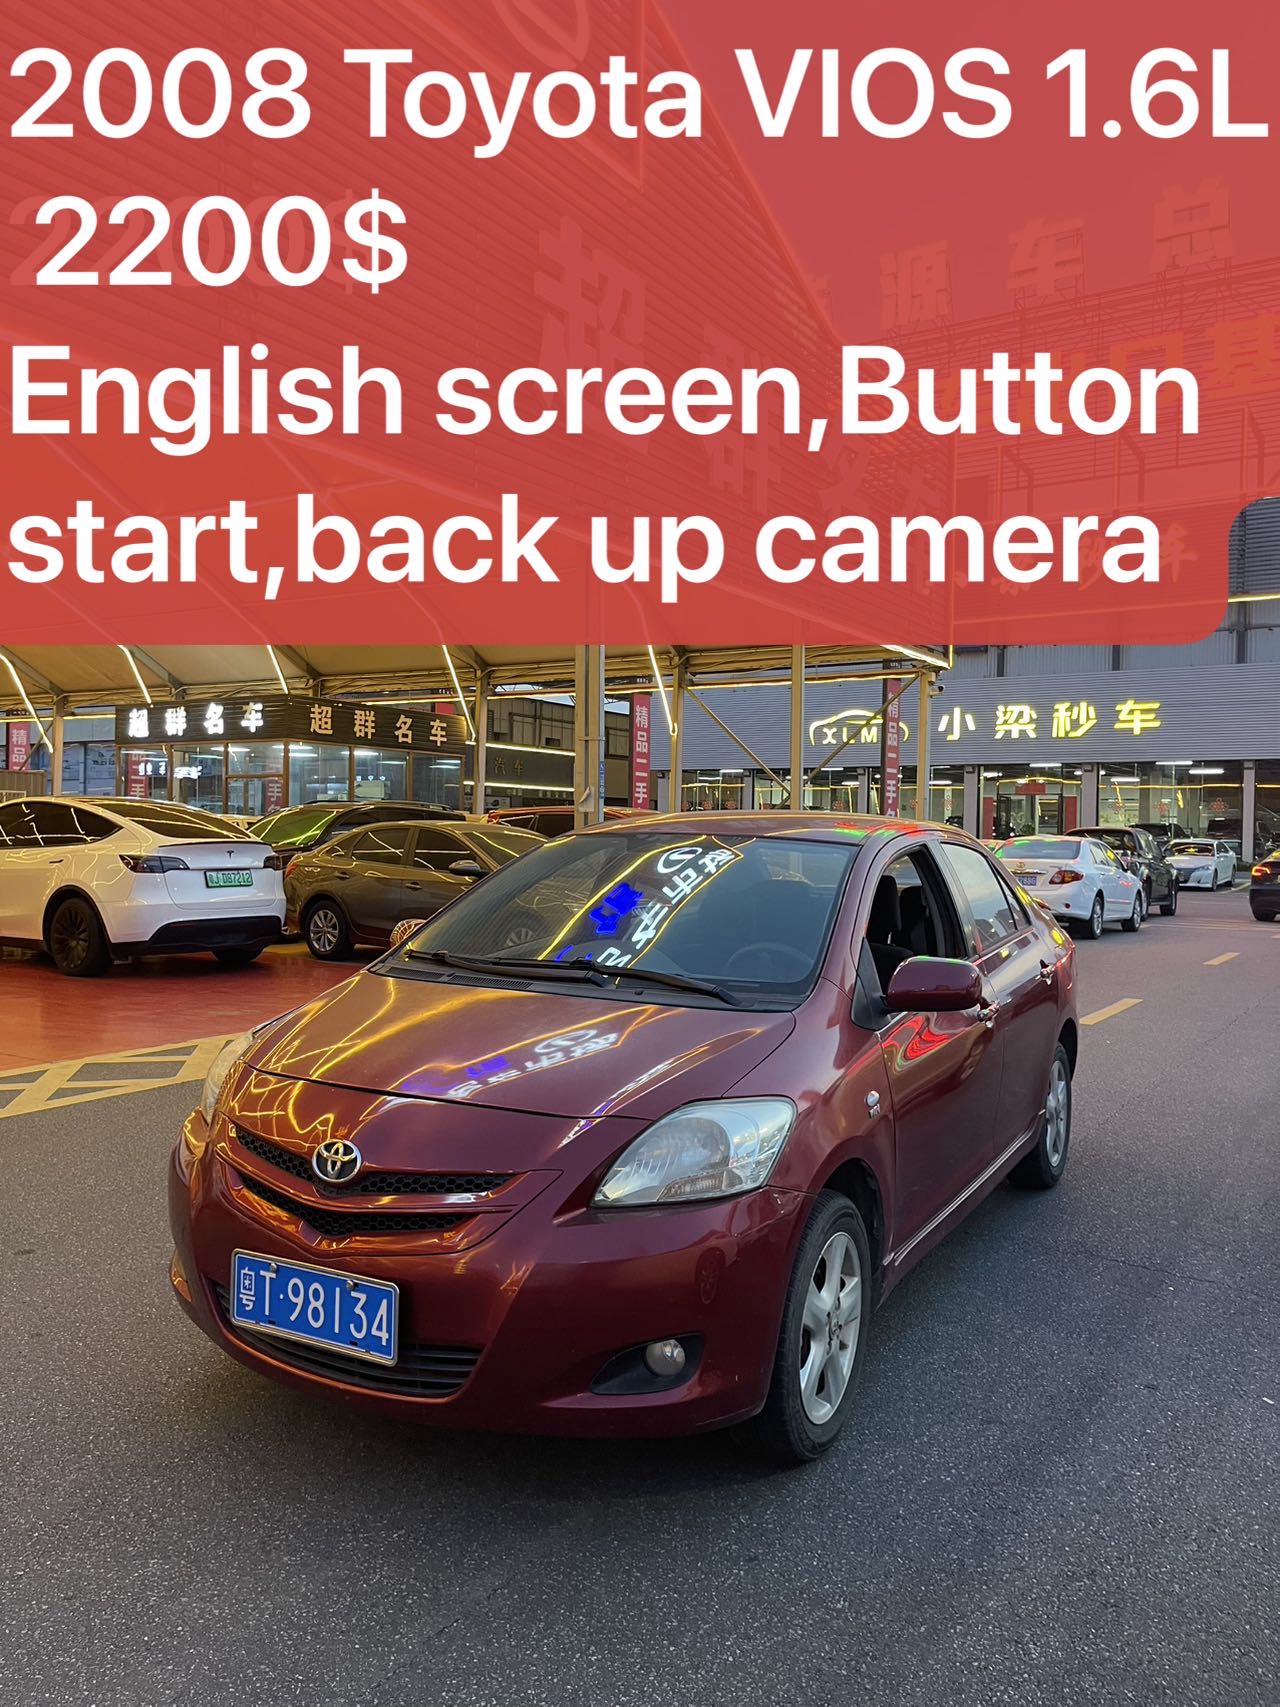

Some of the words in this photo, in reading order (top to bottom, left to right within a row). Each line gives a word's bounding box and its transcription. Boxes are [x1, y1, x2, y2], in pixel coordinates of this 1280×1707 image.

[310, 704, 448, 747] 超群名车
[822, 727, 878, 744] XLM
[937, 699, 1161, 741] 小梁秒车
[12, 729, 27, 770] 精品
[635, 705, 649, 809] 精品二手
